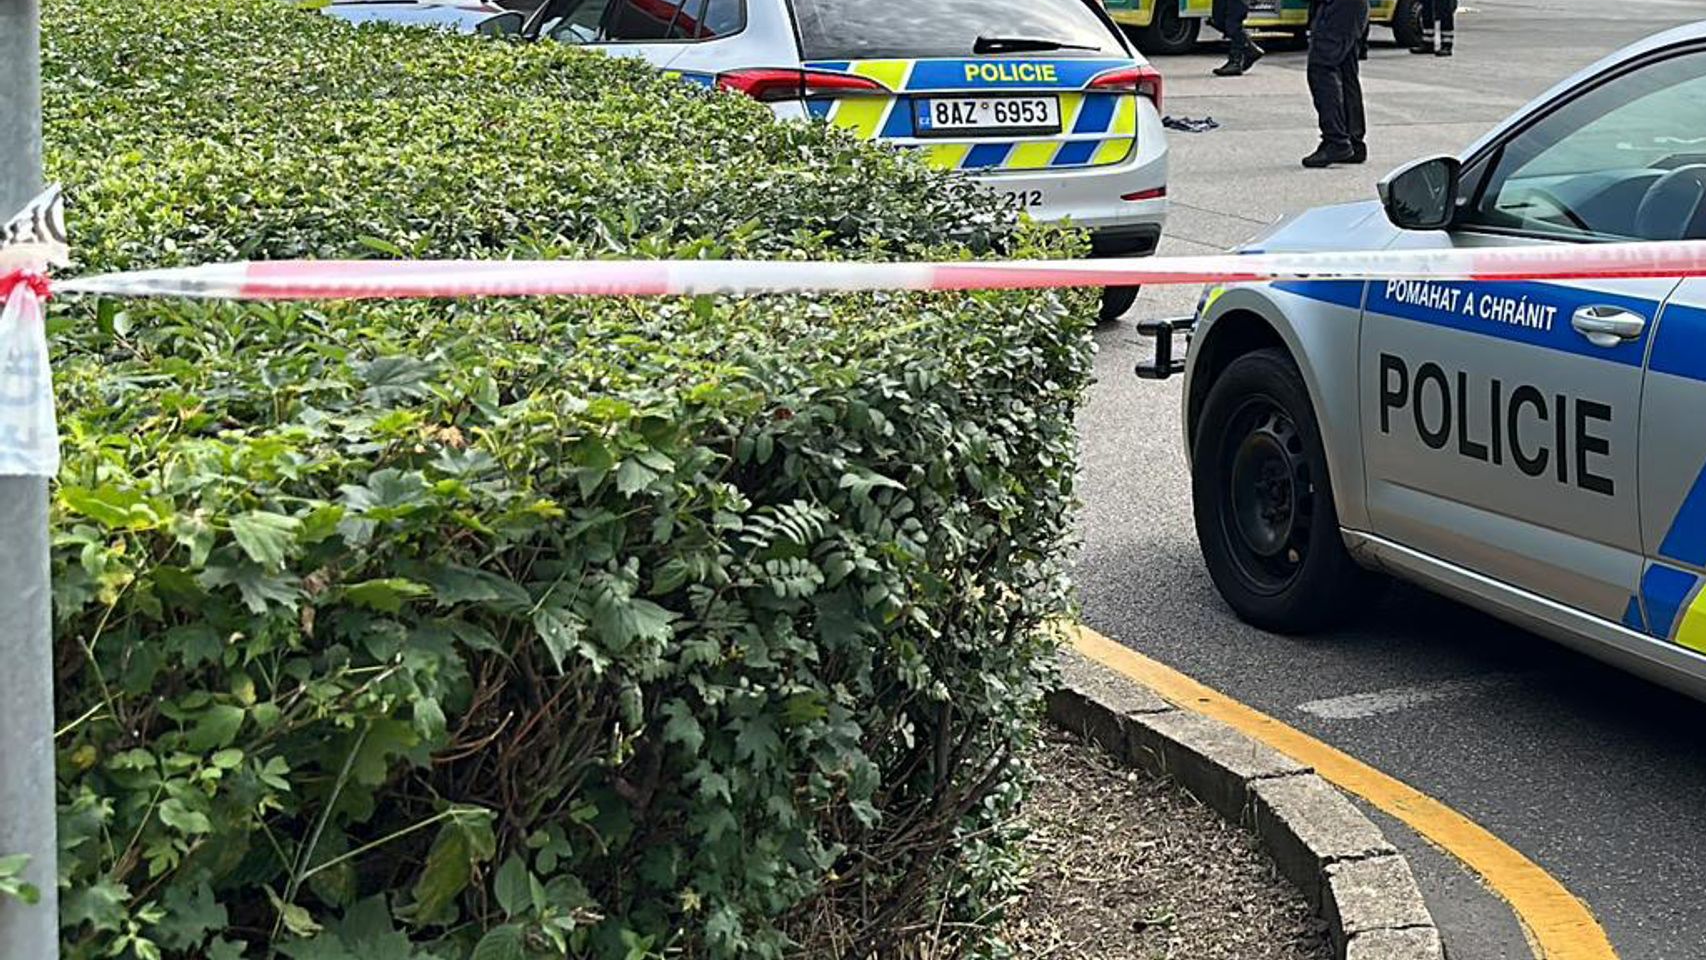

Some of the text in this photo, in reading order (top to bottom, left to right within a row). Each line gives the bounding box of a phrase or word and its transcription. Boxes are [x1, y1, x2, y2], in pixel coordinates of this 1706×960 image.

[964, 63, 1057, 82] POLICIE
[935, 100, 1048, 125] 8AZ 6953
[1004, 190, 1042, 208] 212
[1385, 279, 1557, 331] POMÁHAT A CHRÁNIT
[1379, 352, 1615, 497] POLICIE
